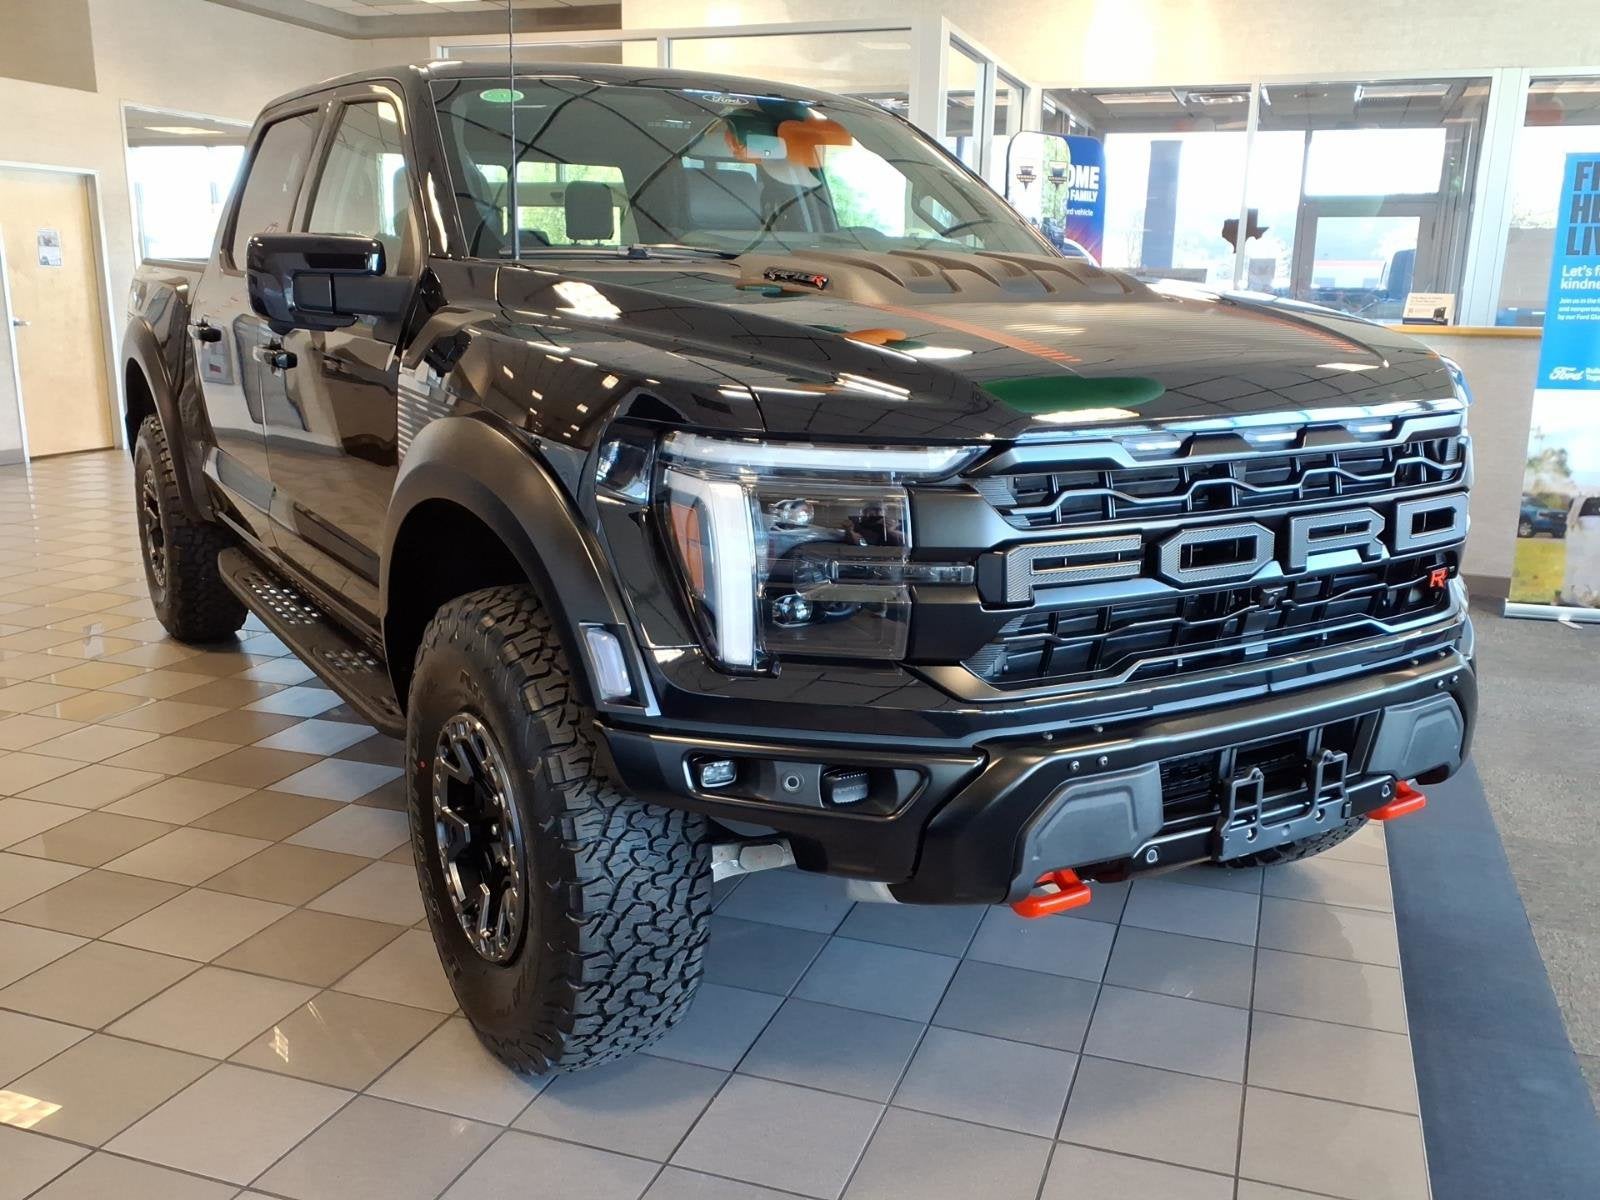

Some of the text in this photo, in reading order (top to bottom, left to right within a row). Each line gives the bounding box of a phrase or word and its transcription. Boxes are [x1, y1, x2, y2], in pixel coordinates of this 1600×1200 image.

[1070, 189, 1098, 202] FAMILY
[1074, 208, 1094, 216] vehicle
[1562, 264, 1593, 277] Let's
[1549, 366, 1585, 381] Ford
[1006, 493, 1469, 602] FORD
[1430, 567, 1448, 588] R
